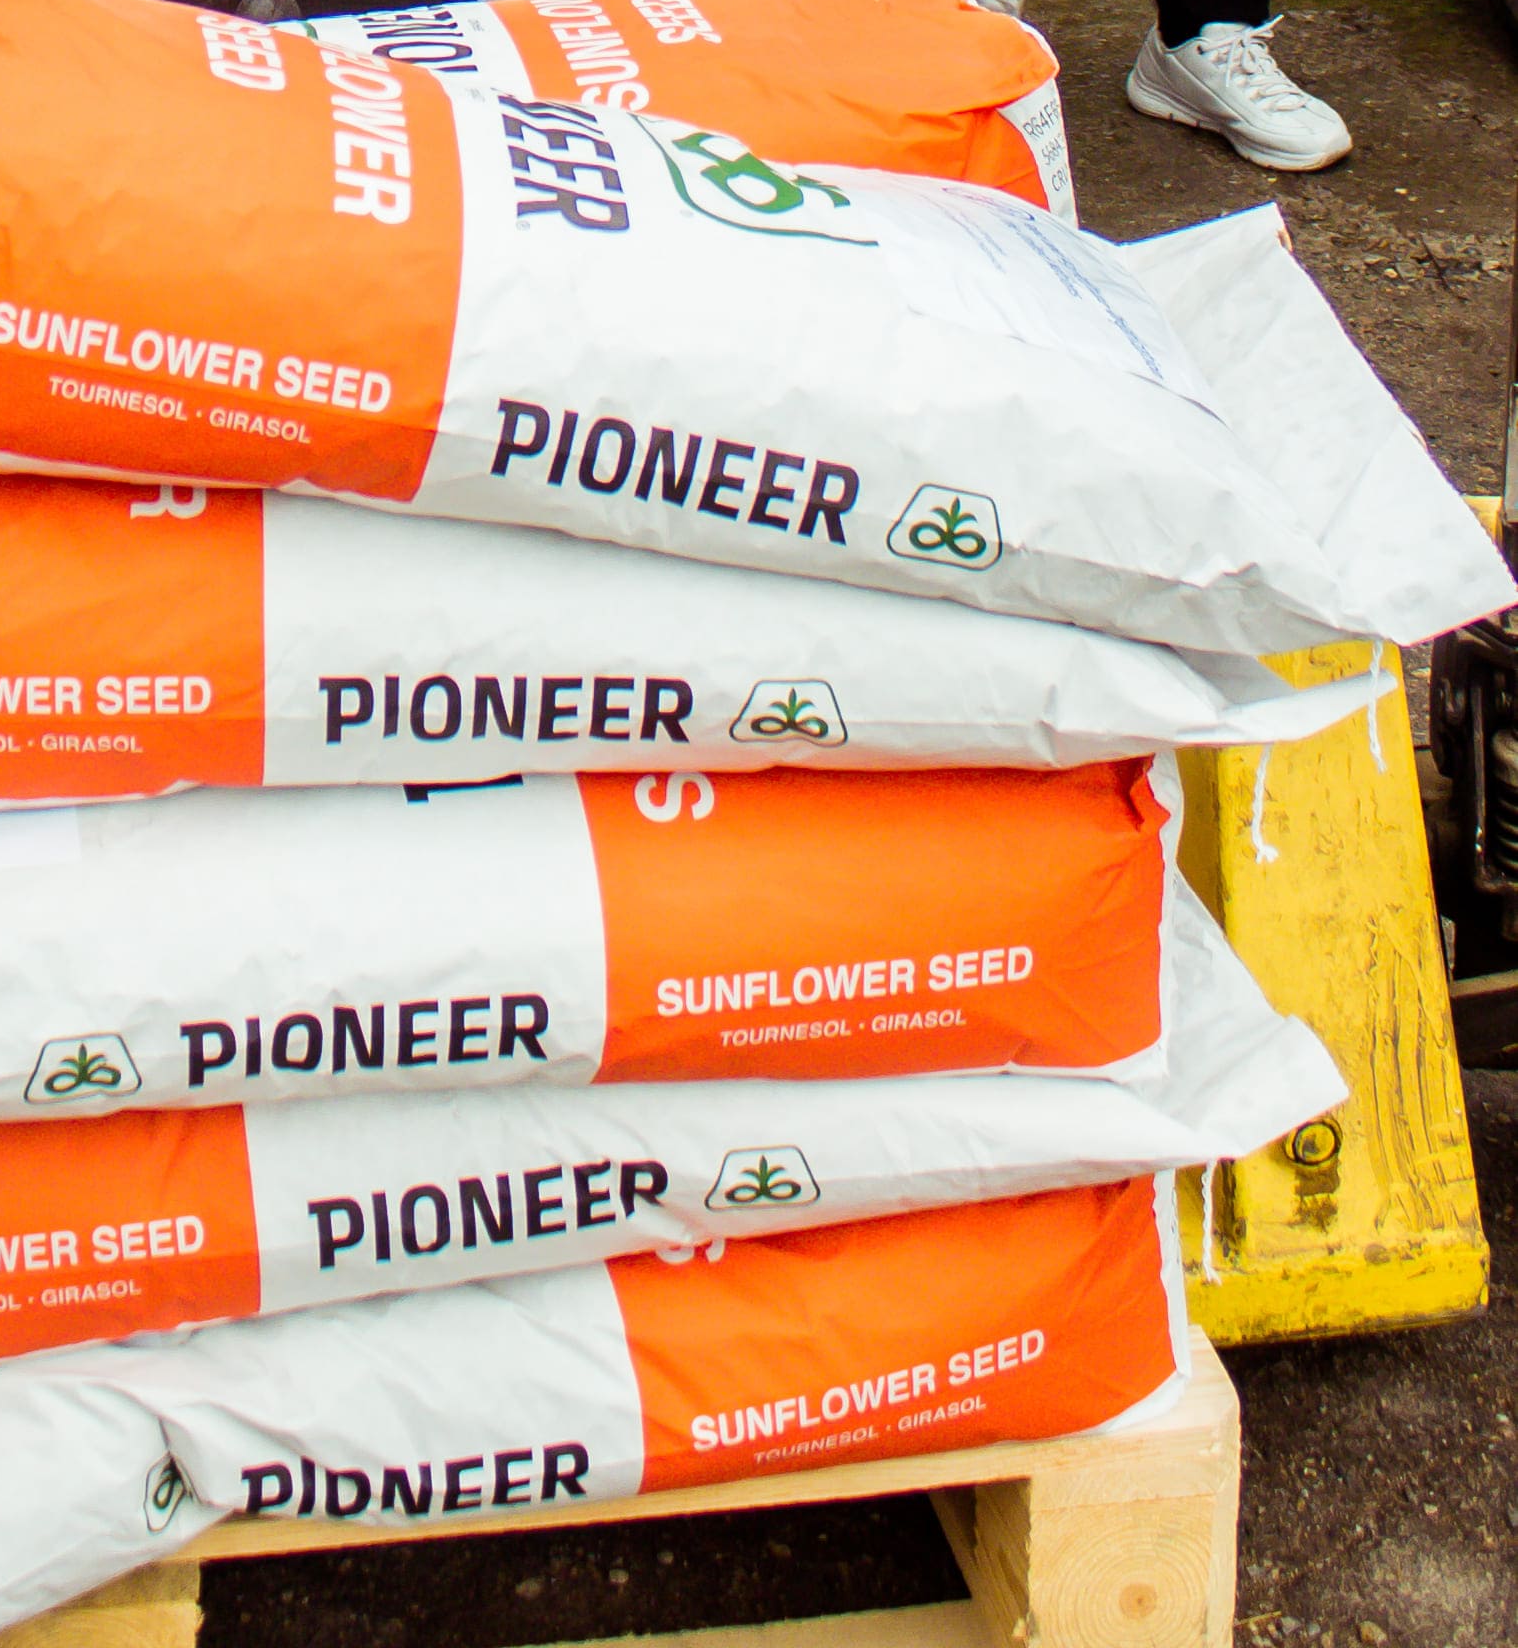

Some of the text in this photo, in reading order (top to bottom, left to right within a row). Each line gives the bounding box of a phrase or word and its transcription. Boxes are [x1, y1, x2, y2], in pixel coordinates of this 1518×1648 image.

[198, 15, 286, 92] SEED
[49, 376, 311, 445] TOURNESOL GIRASOL
[275, 356, 391, 413] SEED
[489, 398, 860, 546] PIONEER
[96, 674, 212, 715] SEED
[318, 674, 694, 744] PIONEER
[41, 733, 143, 754] GIRASOL
[657, 944, 1035, 1019] SUNFLOWER SEED
[180, 994, 550, 1088] PIONEER
[719, 1009, 968, 1049] TOURNESOL GIRASOL
[91, 1214, 205, 1265] SEED
[308, 1158, 670, 1271] PIONEER
[41, 1279, 142, 1308] GIRASOL
[690, 1327, 1047, 1454] SUNFLOWER SEED
[753, 1393, 989, 1466] TOURNESOL GIRASOL
[241, 1441, 592, 1519] PIONEER
